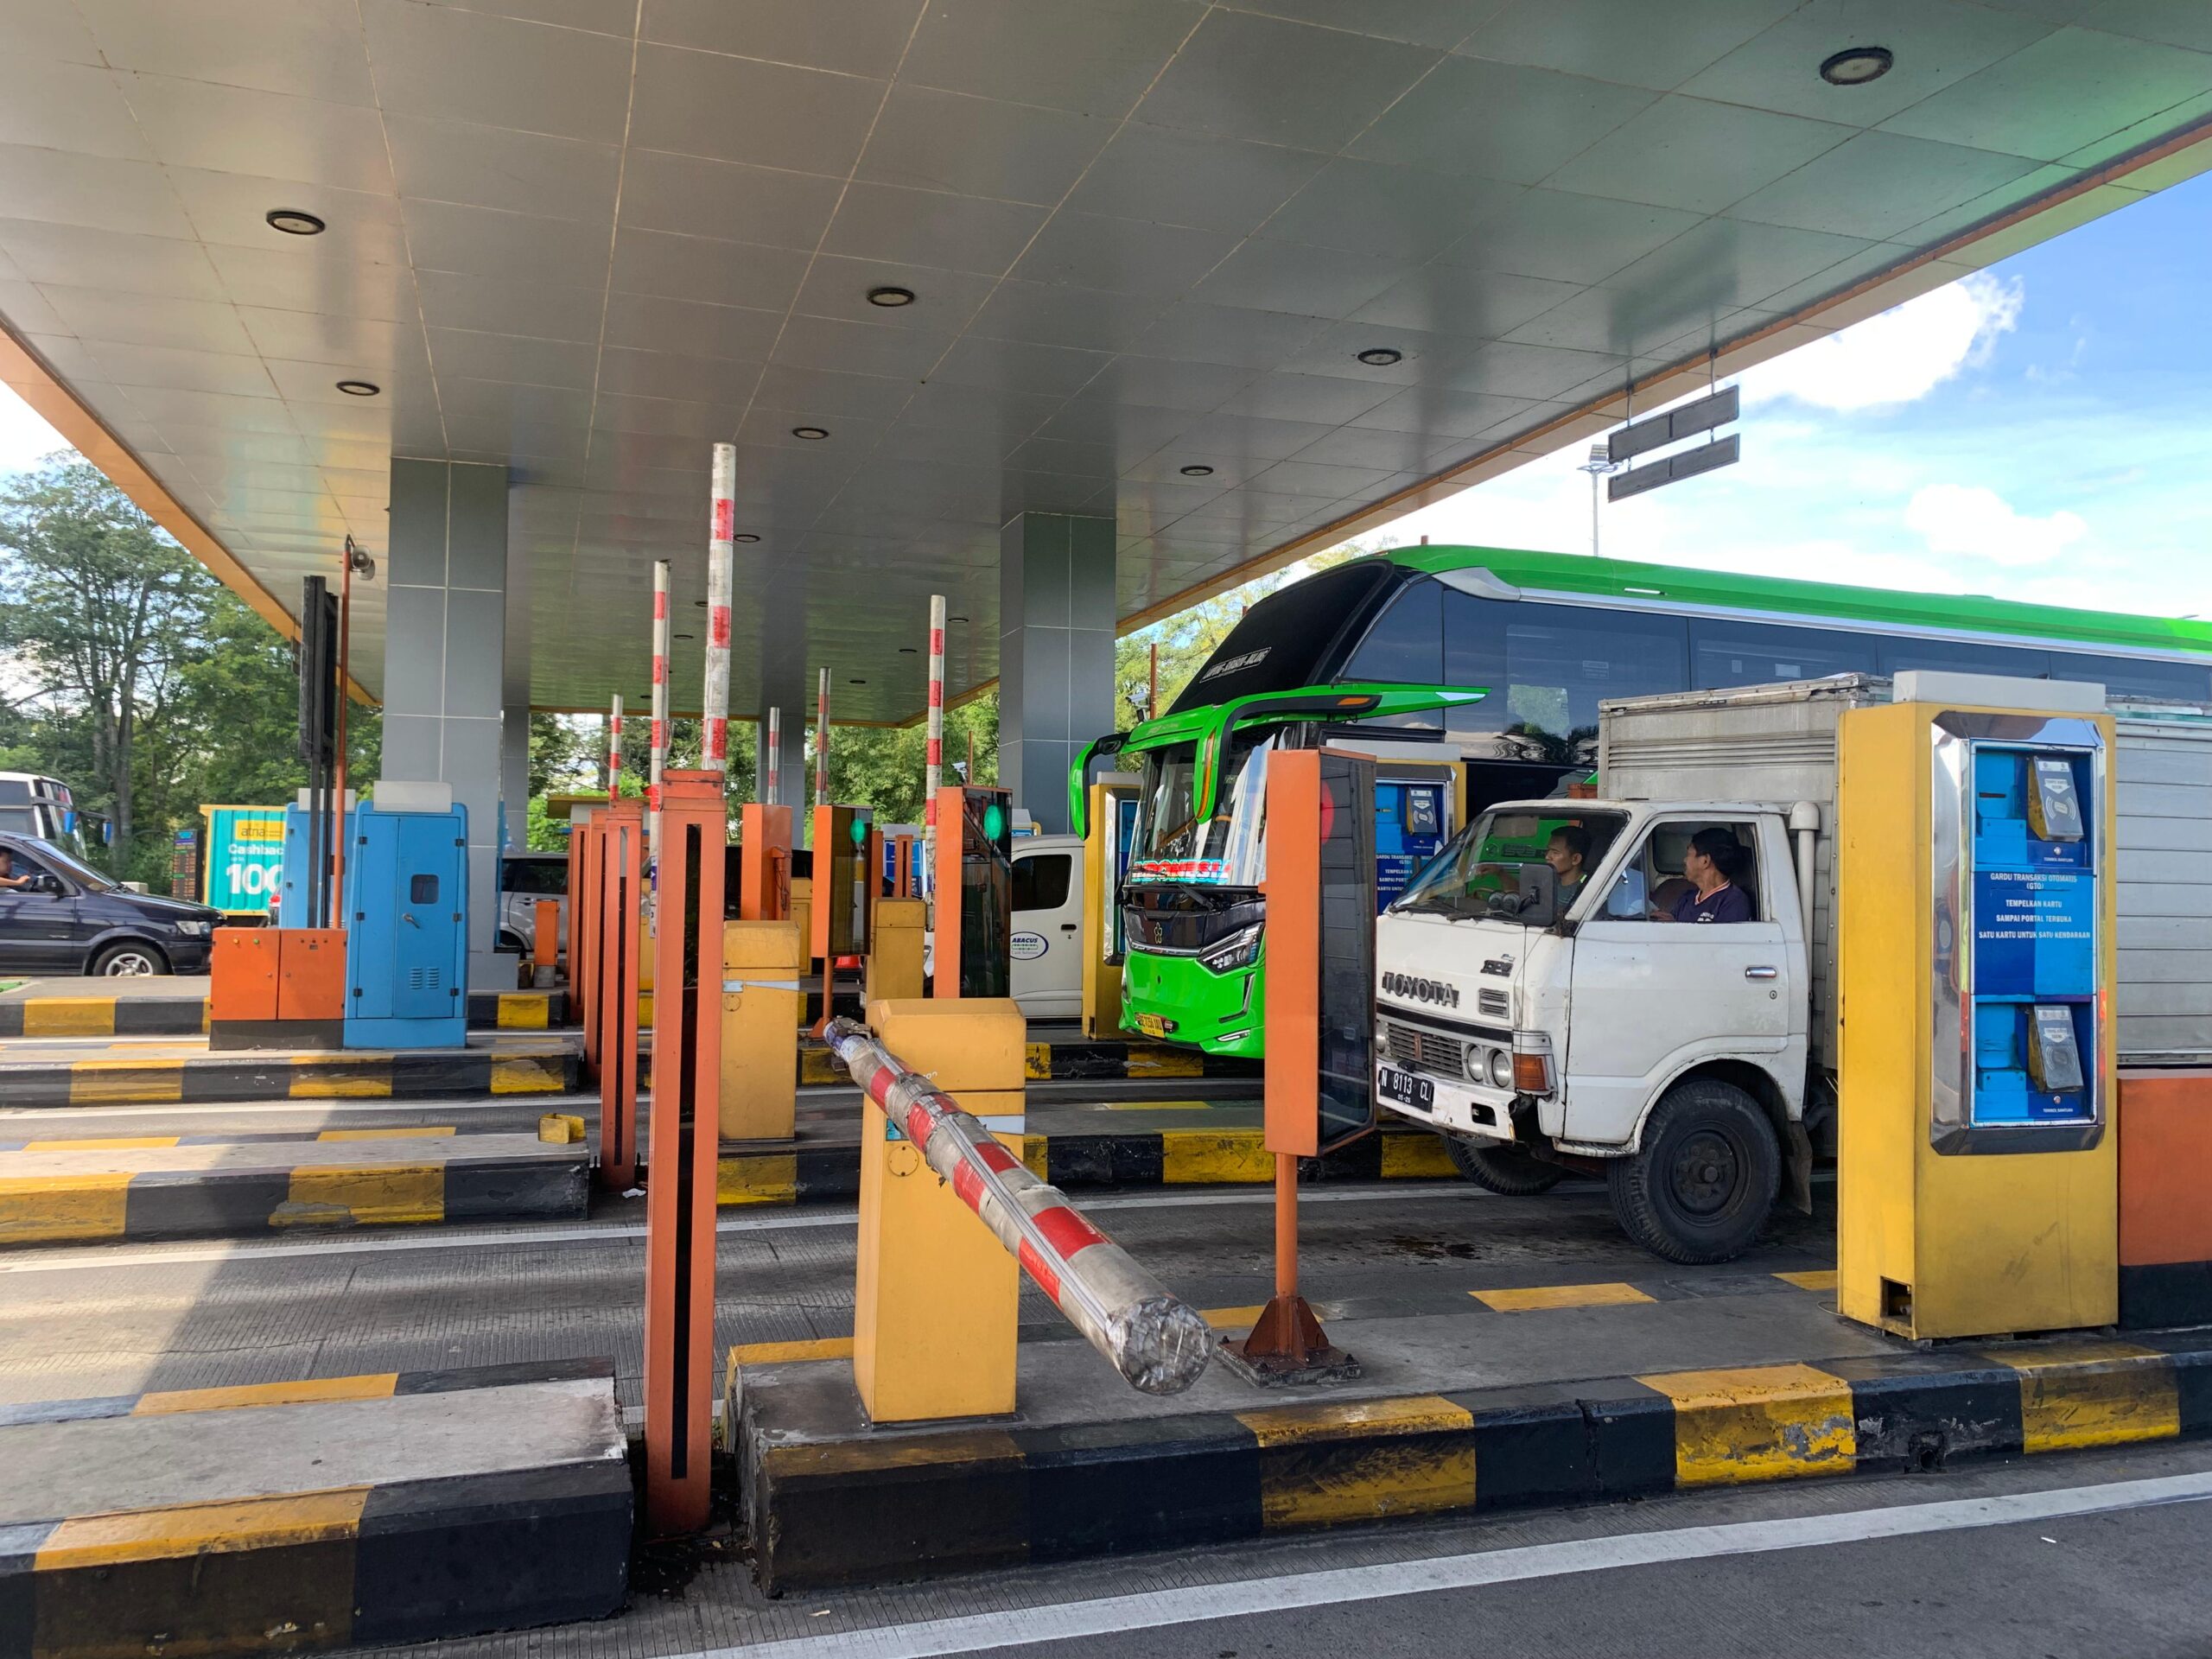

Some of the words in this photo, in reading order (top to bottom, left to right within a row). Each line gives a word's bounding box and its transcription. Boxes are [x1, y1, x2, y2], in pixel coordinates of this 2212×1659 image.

[1990, 873, 2012, 881] GARDU
[2013, 873, 2047, 882] TRANSAKSI
[2049, 874, 2077, 883] OTOMATIS
[1382, 971, 1459, 1008] TOYOTA
[1381, 1069, 1388, 1087] N
[1393, 1072, 1413, 1095] 8113
[1420, 1081, 1429, 1102] CL
